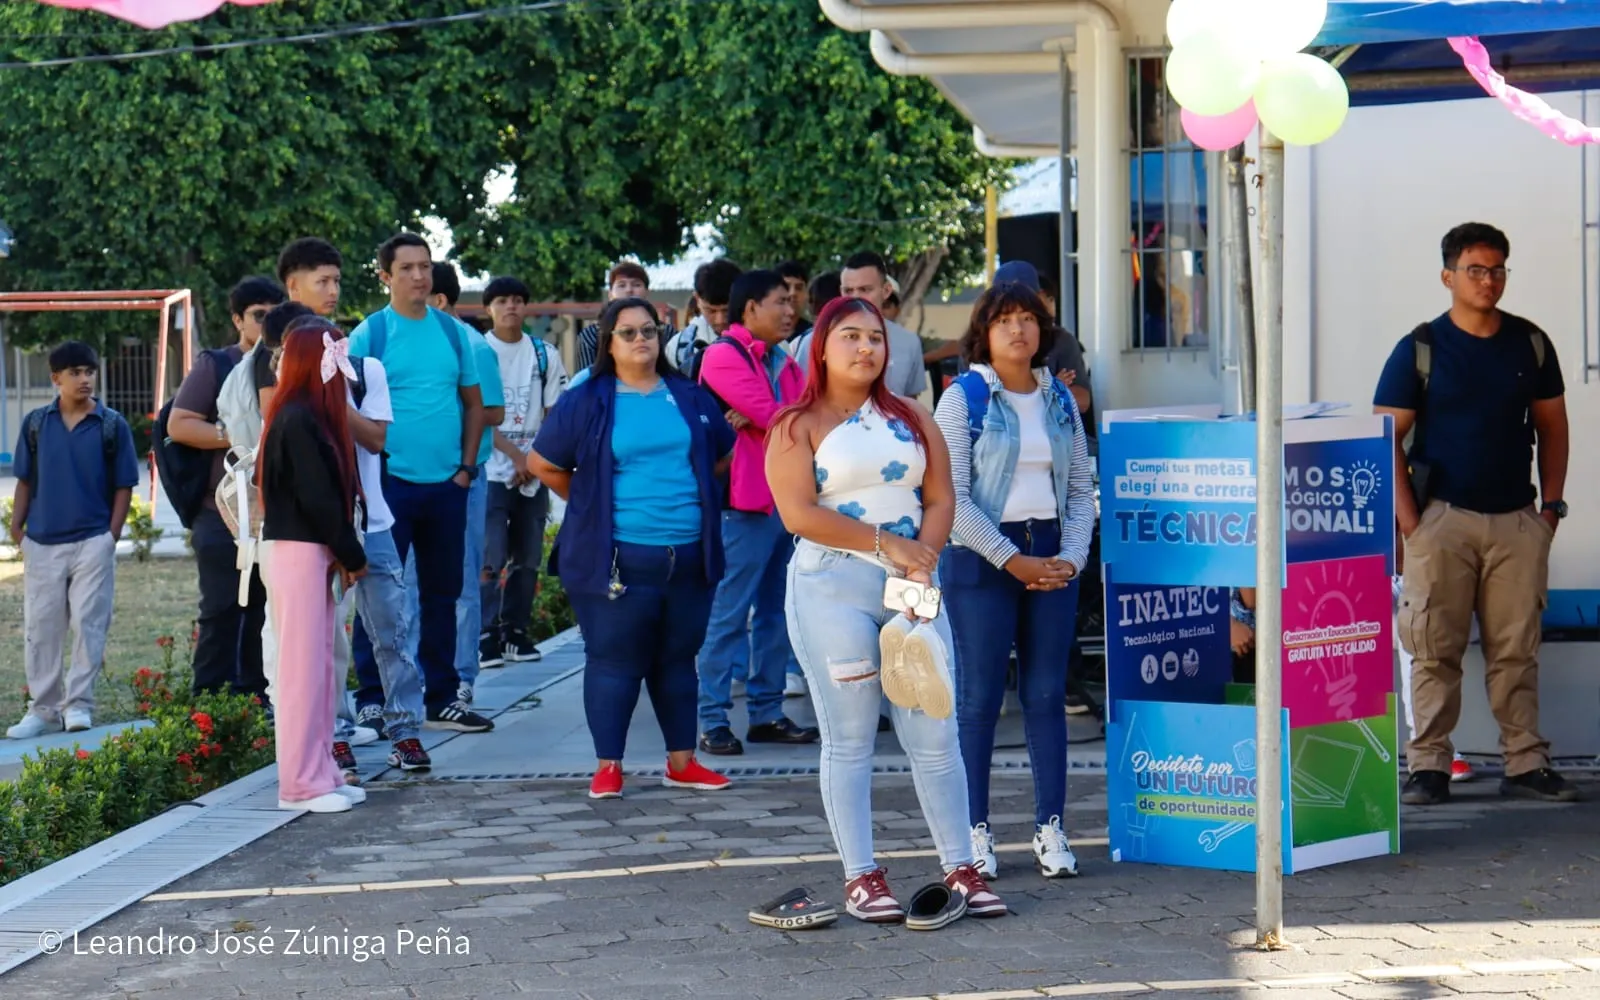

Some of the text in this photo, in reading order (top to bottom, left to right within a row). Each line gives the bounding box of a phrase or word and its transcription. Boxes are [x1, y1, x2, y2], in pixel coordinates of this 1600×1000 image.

[1172, 463, 1190, 473] tus
[1194, 462, 1245, 477] metas
[1120, 478, 1157, 496] elegí
[1162, 482, 1189, 493] una
[1118, 586, 1220, 627] INATEC
[1123, 623, 1215, 647] Tecnológico Nacional
[1325, 645, 1332, 657] Y
[1332, 643, 1343, 656] DE
[1344, 639, 1376, 655] CALIDAD
[1205, 762, 1234, 779] por
[1136, 771, 1168, 793] UN
[1139, 797, 1156, 811] de
